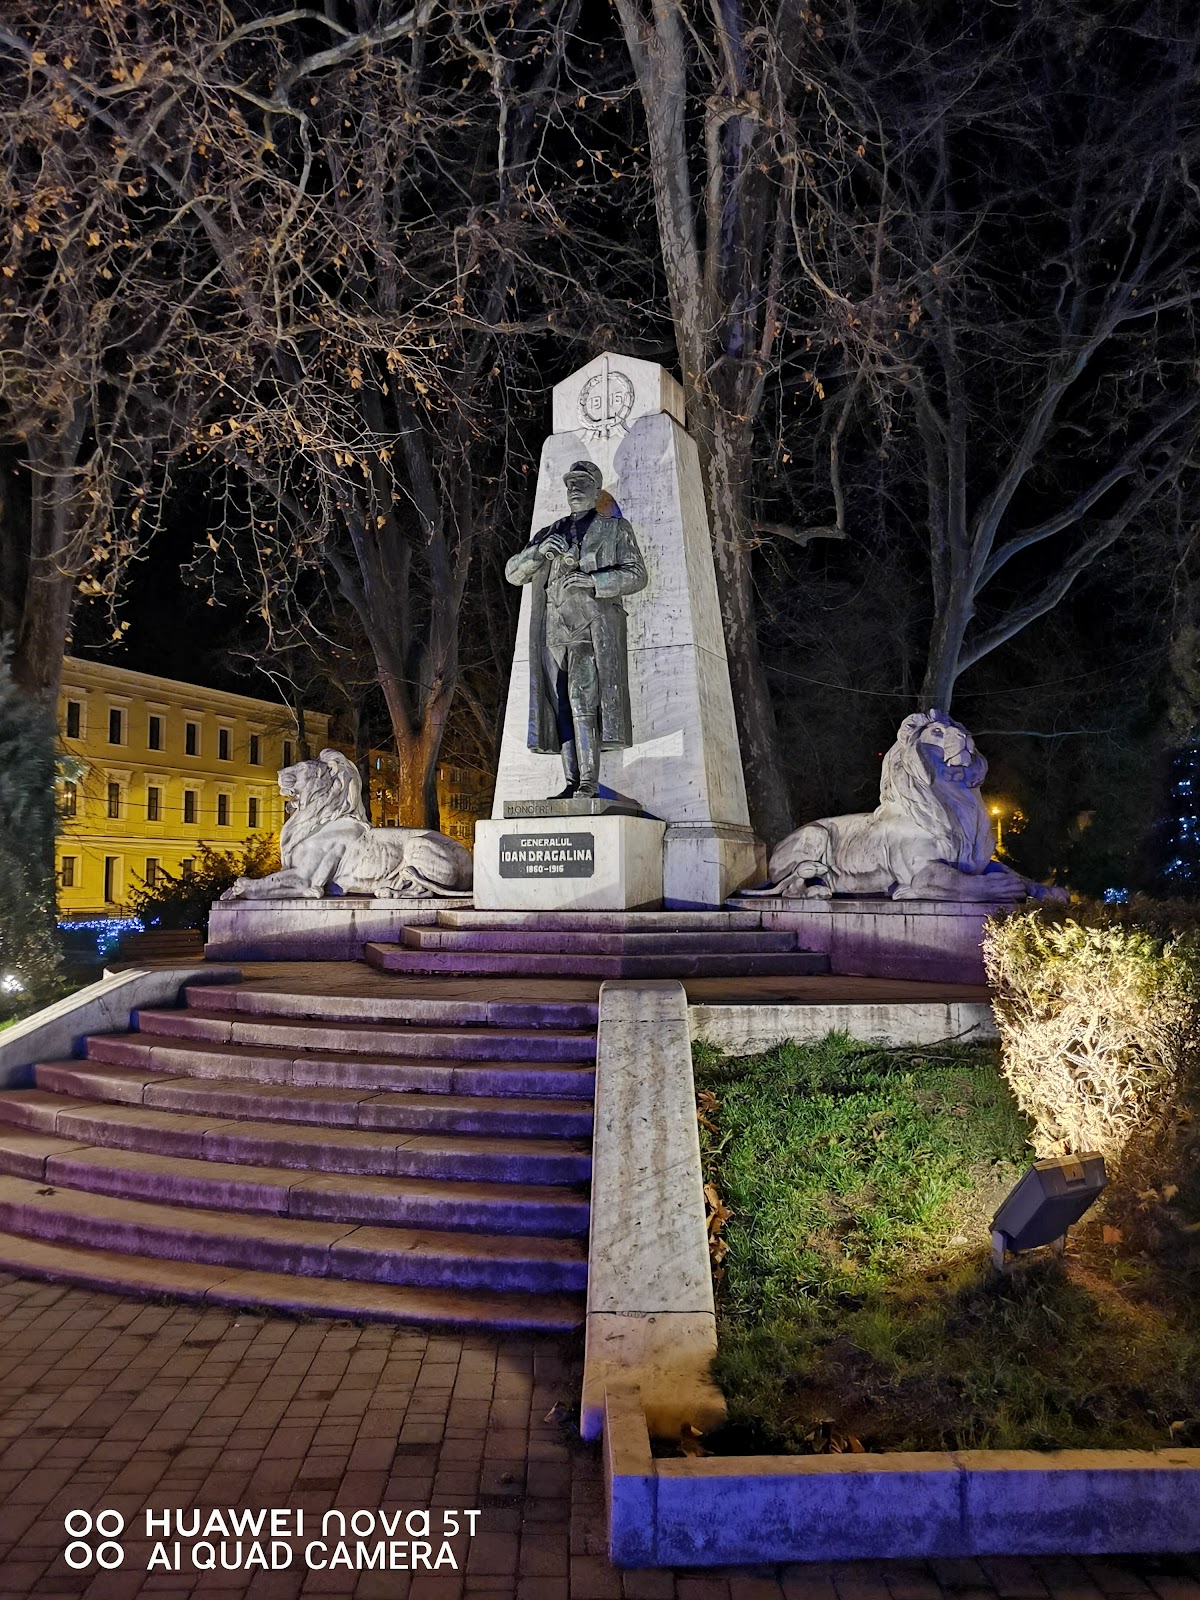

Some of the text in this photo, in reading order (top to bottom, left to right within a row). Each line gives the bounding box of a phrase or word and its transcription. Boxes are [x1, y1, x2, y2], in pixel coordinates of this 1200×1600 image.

[520, 838, 572, 847] GENERALUL
[501, 849, 592, 862] IOAN DRAGALINA
[526, 865, 564, 873] 1860-1916
